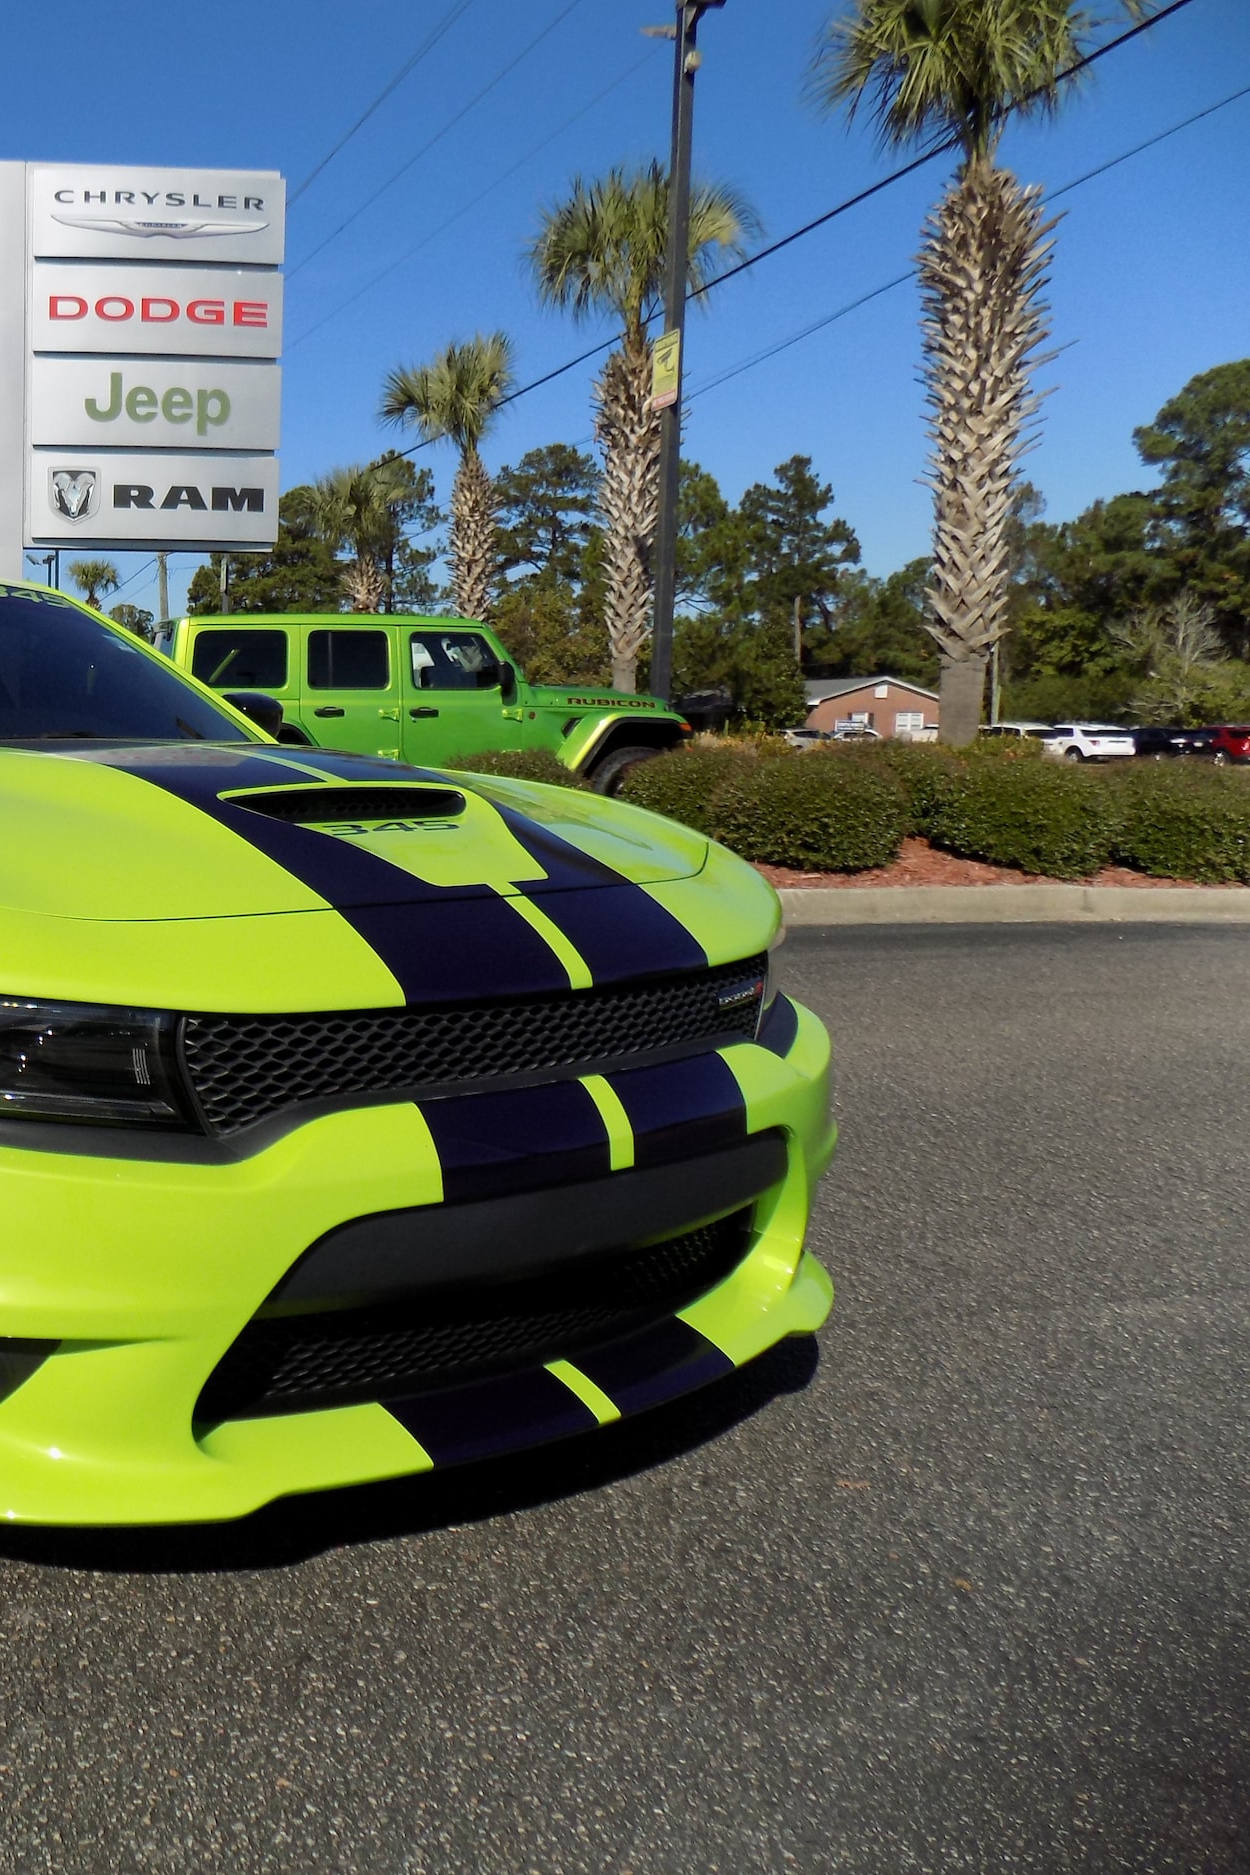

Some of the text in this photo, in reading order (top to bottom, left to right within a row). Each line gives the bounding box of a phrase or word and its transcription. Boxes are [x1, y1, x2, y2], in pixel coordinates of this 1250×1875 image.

[54, 190, 265, 211] CHRYSLER
[49, 296, 268, 328] DODGE
[84, 372, 231, 436] Jeep
[113, 484, 264, 513] RAM
[567, 697, 655, 709] RUBICON
[322, 819, 460, 836] 345
